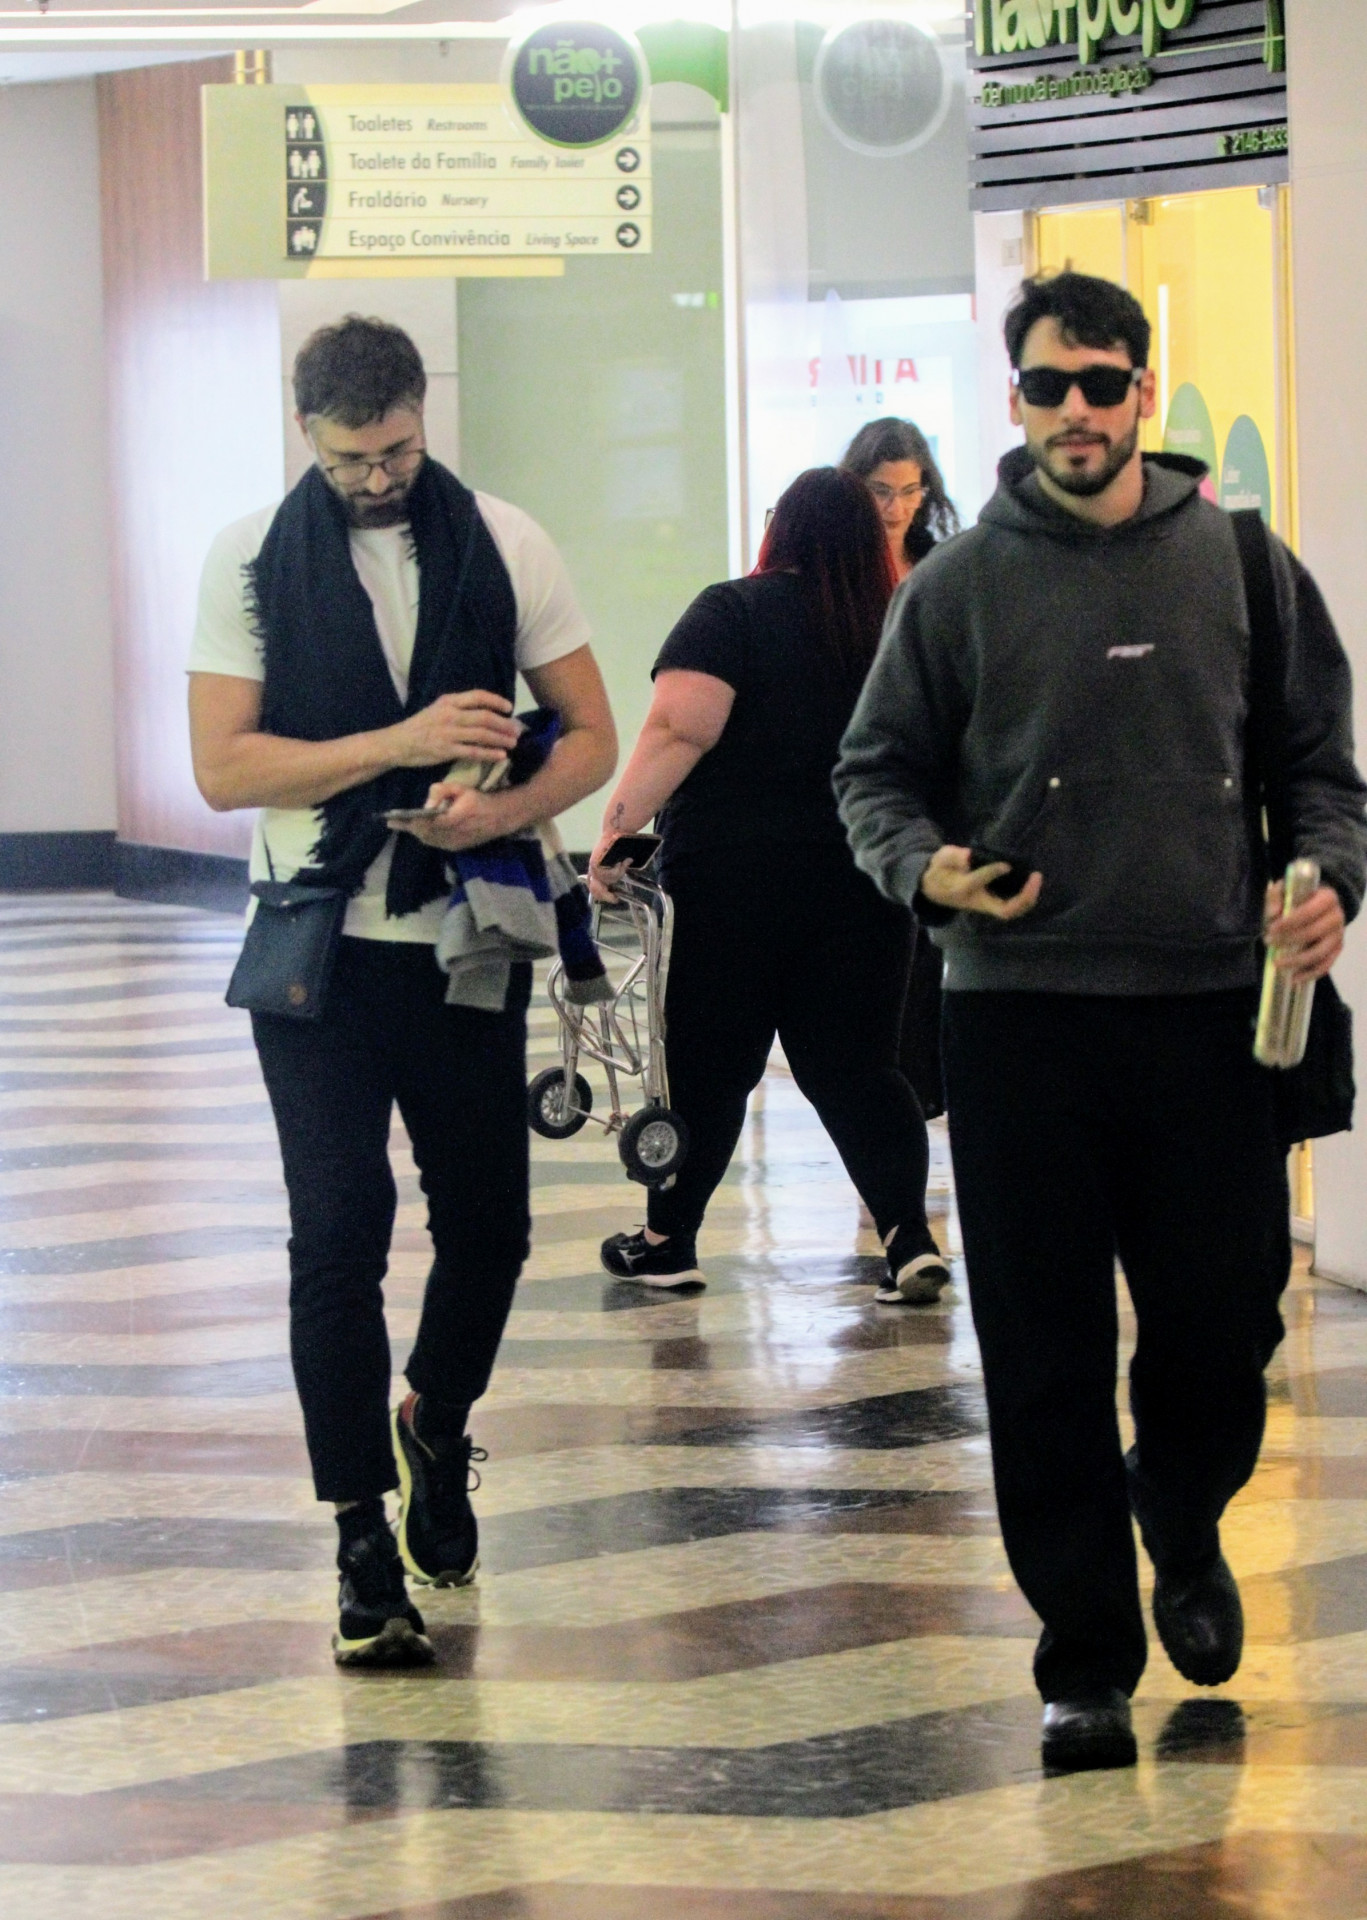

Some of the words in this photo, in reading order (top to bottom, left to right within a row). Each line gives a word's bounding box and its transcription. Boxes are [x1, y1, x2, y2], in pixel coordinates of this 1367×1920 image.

[348, 114, 413, 132] Toaletes
[427, 118, 488, 131] Restrooms
[348, 152, 406, 169] Toalete
[411, 151, 431, 169] da
[437, 151, 497, 169] Família
[511, 155, 549, 170] Family
[348, 190, 427, 208] Fraldário
[441, 193, 489, 208] Nursery
[348, 229, 406, 251] Espaço
[411, 229, 510, 247] Convivência
[526, 232, 561, 247] Living
[565, 232, 599, 247] Space
